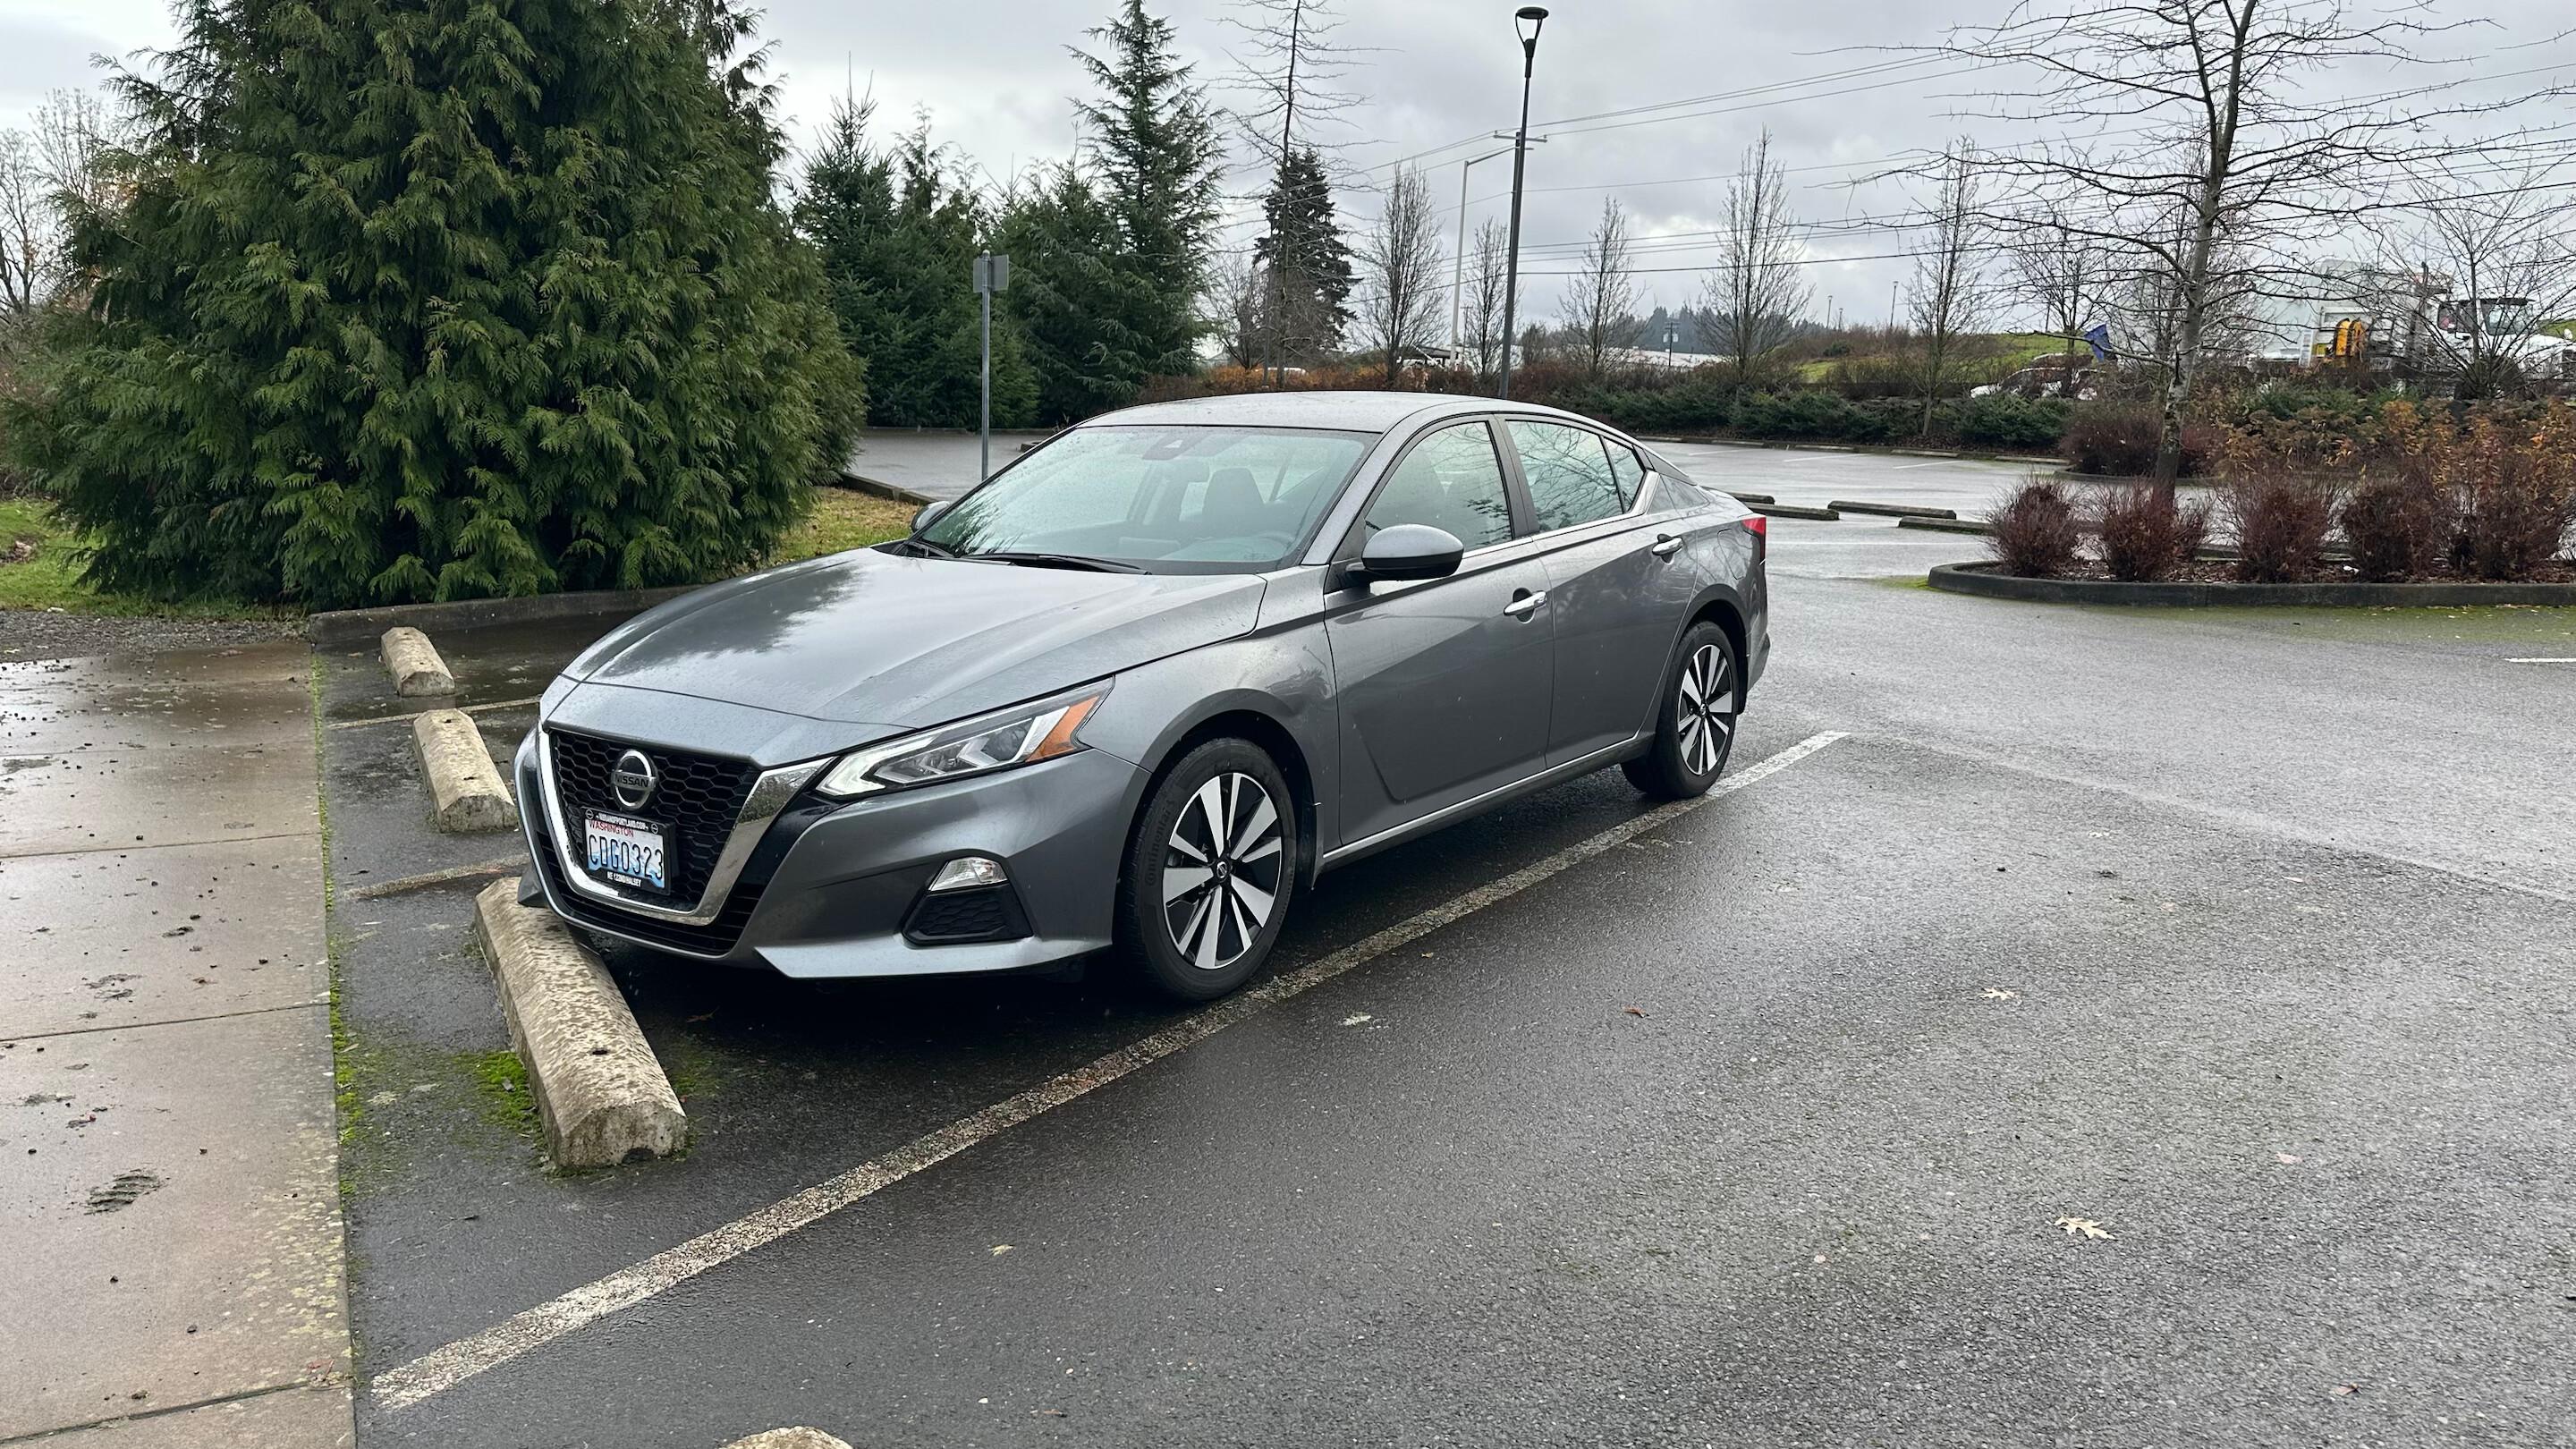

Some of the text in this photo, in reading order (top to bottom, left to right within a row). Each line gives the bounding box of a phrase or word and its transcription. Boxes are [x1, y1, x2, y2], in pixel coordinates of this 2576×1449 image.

[617, 775, 648, 787] NISSAN
[589, 819, 634, 837] WASHINGTON
[589, 834, 663, 880] CDG0323
